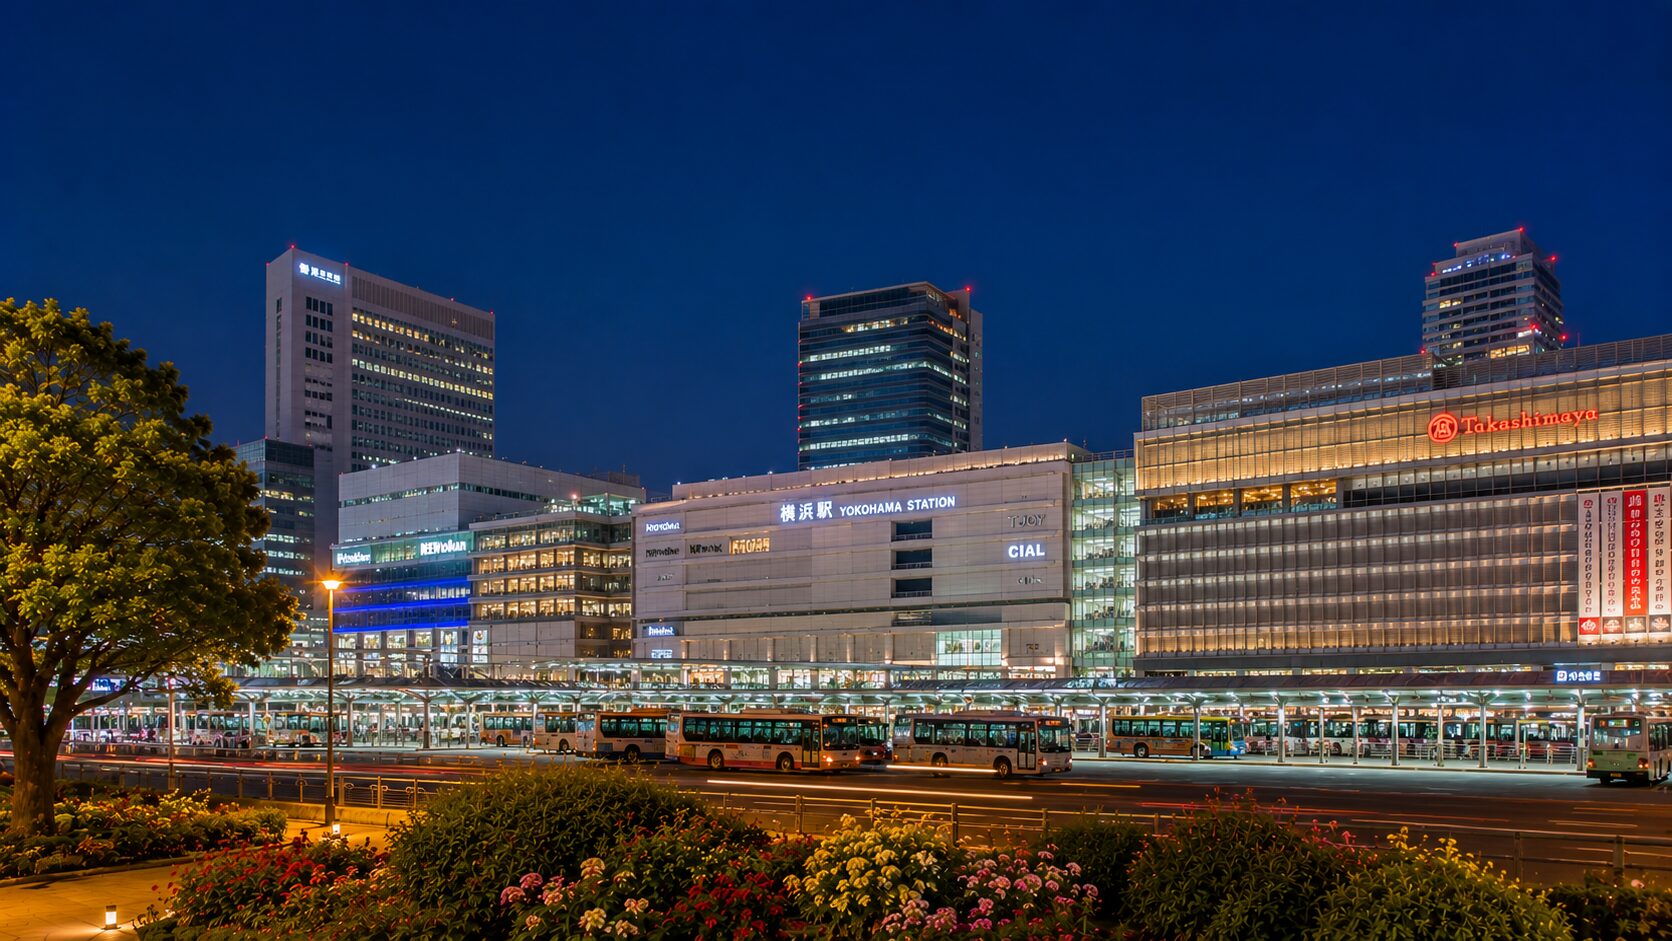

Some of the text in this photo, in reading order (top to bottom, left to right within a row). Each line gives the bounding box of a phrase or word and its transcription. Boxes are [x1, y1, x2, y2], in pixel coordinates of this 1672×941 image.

[1461, 408, 1599, 435] Takashimaya
[780, 500, 833, 522] 横浜駅
[839, 496, 956, 517] YOKOHAMA STATION
[1008, 543, 1046, 558] CIAL
